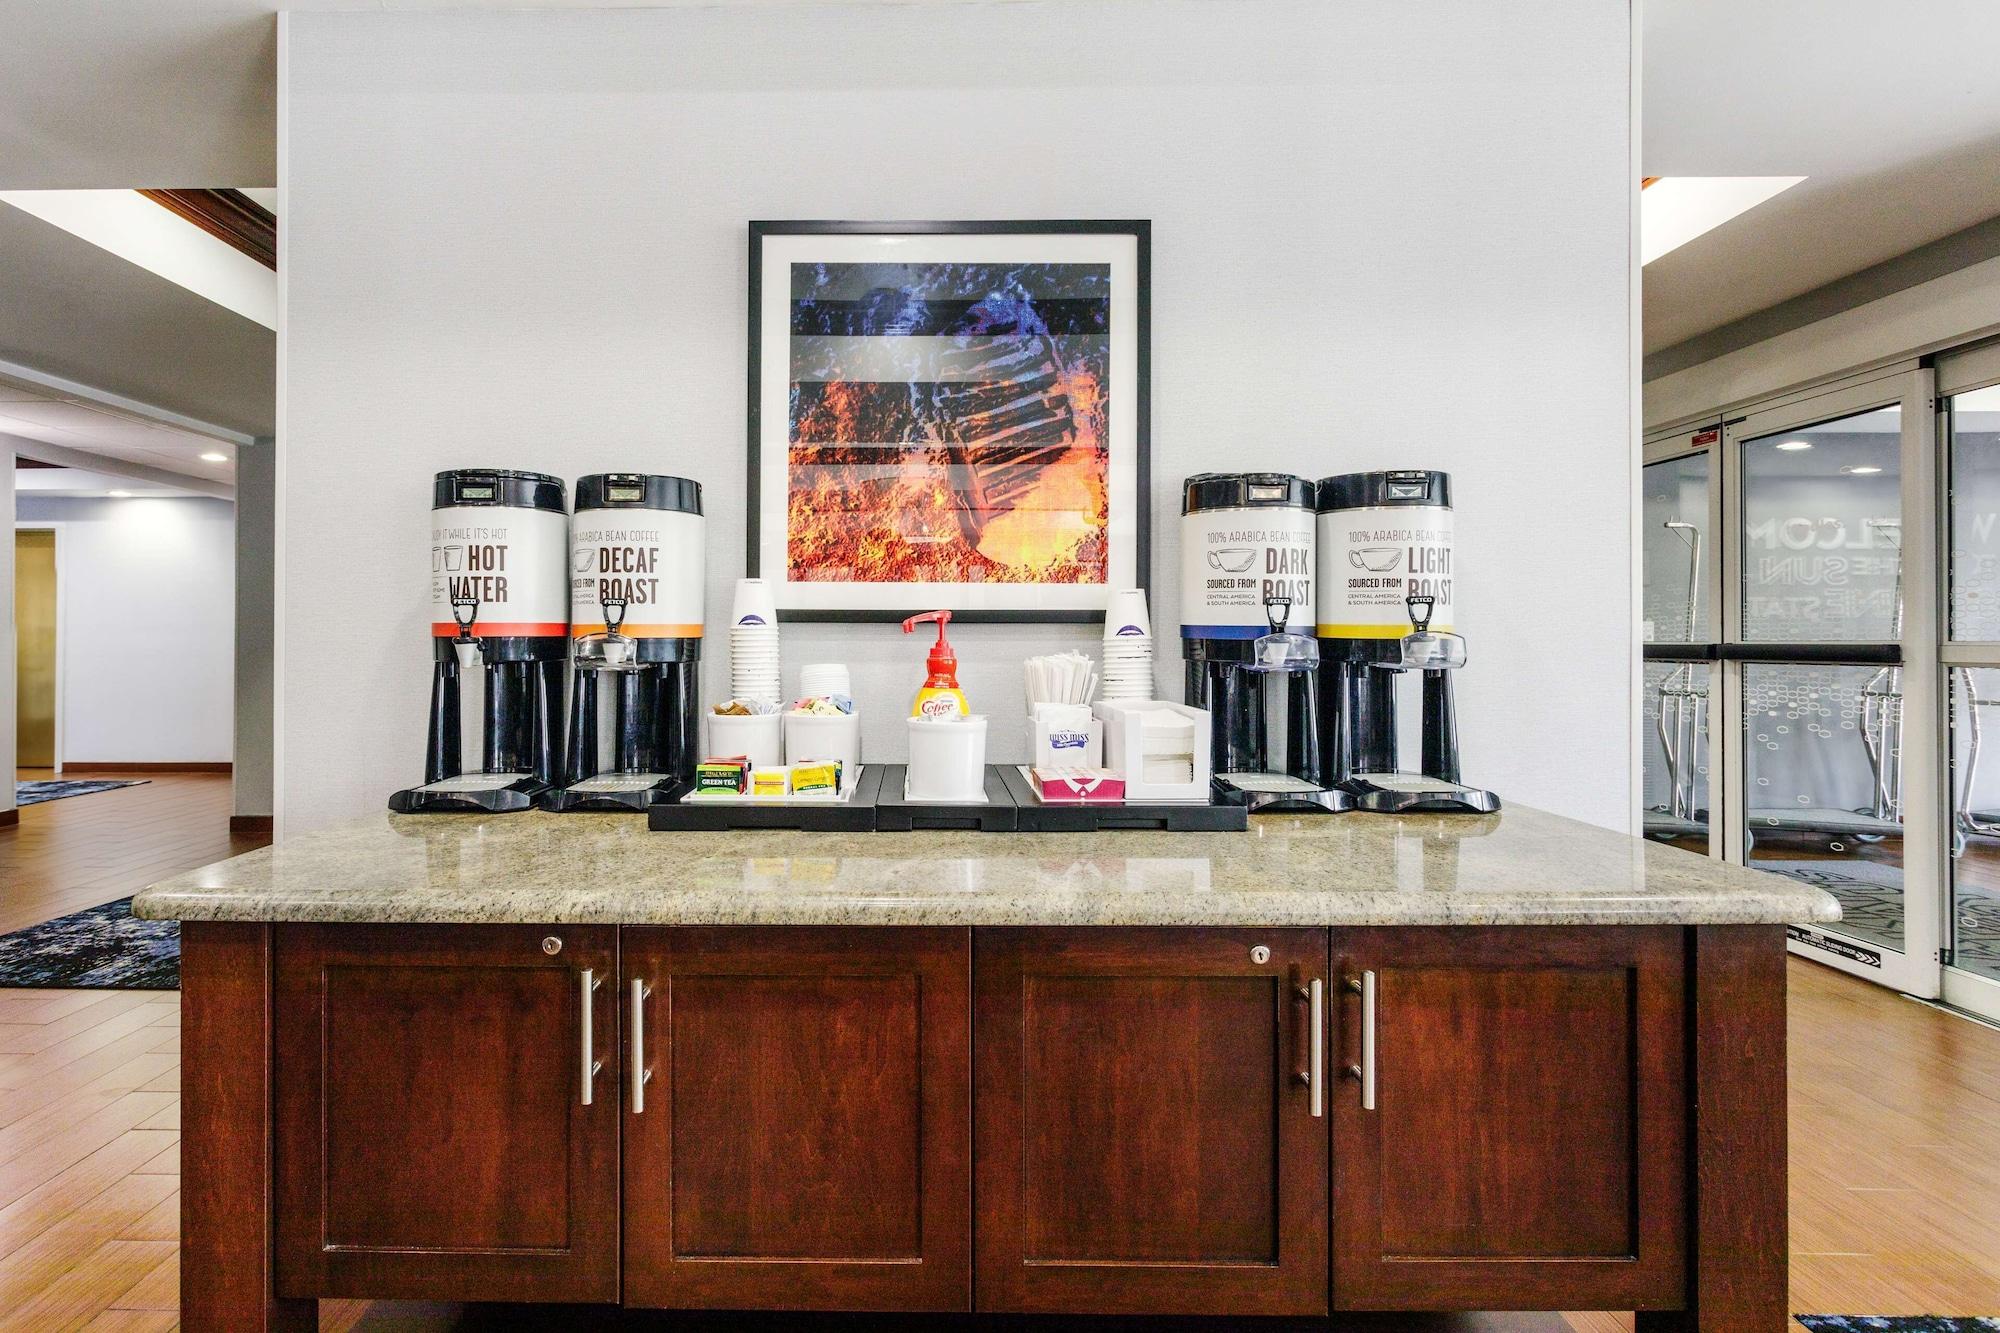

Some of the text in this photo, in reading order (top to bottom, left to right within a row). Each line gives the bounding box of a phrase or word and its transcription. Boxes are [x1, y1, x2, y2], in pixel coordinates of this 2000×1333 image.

[448, 528, 471, 540] WHILE
[474, 527, 489, 540] IT'S
[491, 528, 508, 540] HOT
[605, 530, 627, 542] BEAN
[629, 530, 659, 542] COFFEE
[1207, 531, 1226, 544] 100%
[1229, 530, 1267, 543] ARABICA
[1270, 530, 1290, 542] BEAN
[1349, 531, 1371, 543] 100%
[1373, 530, 1412, 542] ARABICA
[1415, 529, 1436, 541] BEAN
[468, 544, 508, 571] HOT
[599, 547, 659, 573] DECAF
[1266, 547, 1308, 574] DARK
[1408, 547, 1451, 574] LIGHT
[448, 576, 508, 603] WATER
[583, 578, 595, 588] FROM
[599, 578, 659, 604] ROAST
[1206, 579, 1257, 588] SOURCED FROM
[1262, 579, 1310, 606] ROAST
[1348, 578, 1402, 588] SOURCED FROM
[1408, 578, 1452, 606] ROAST
[723, 778, 737, 786] TEA
